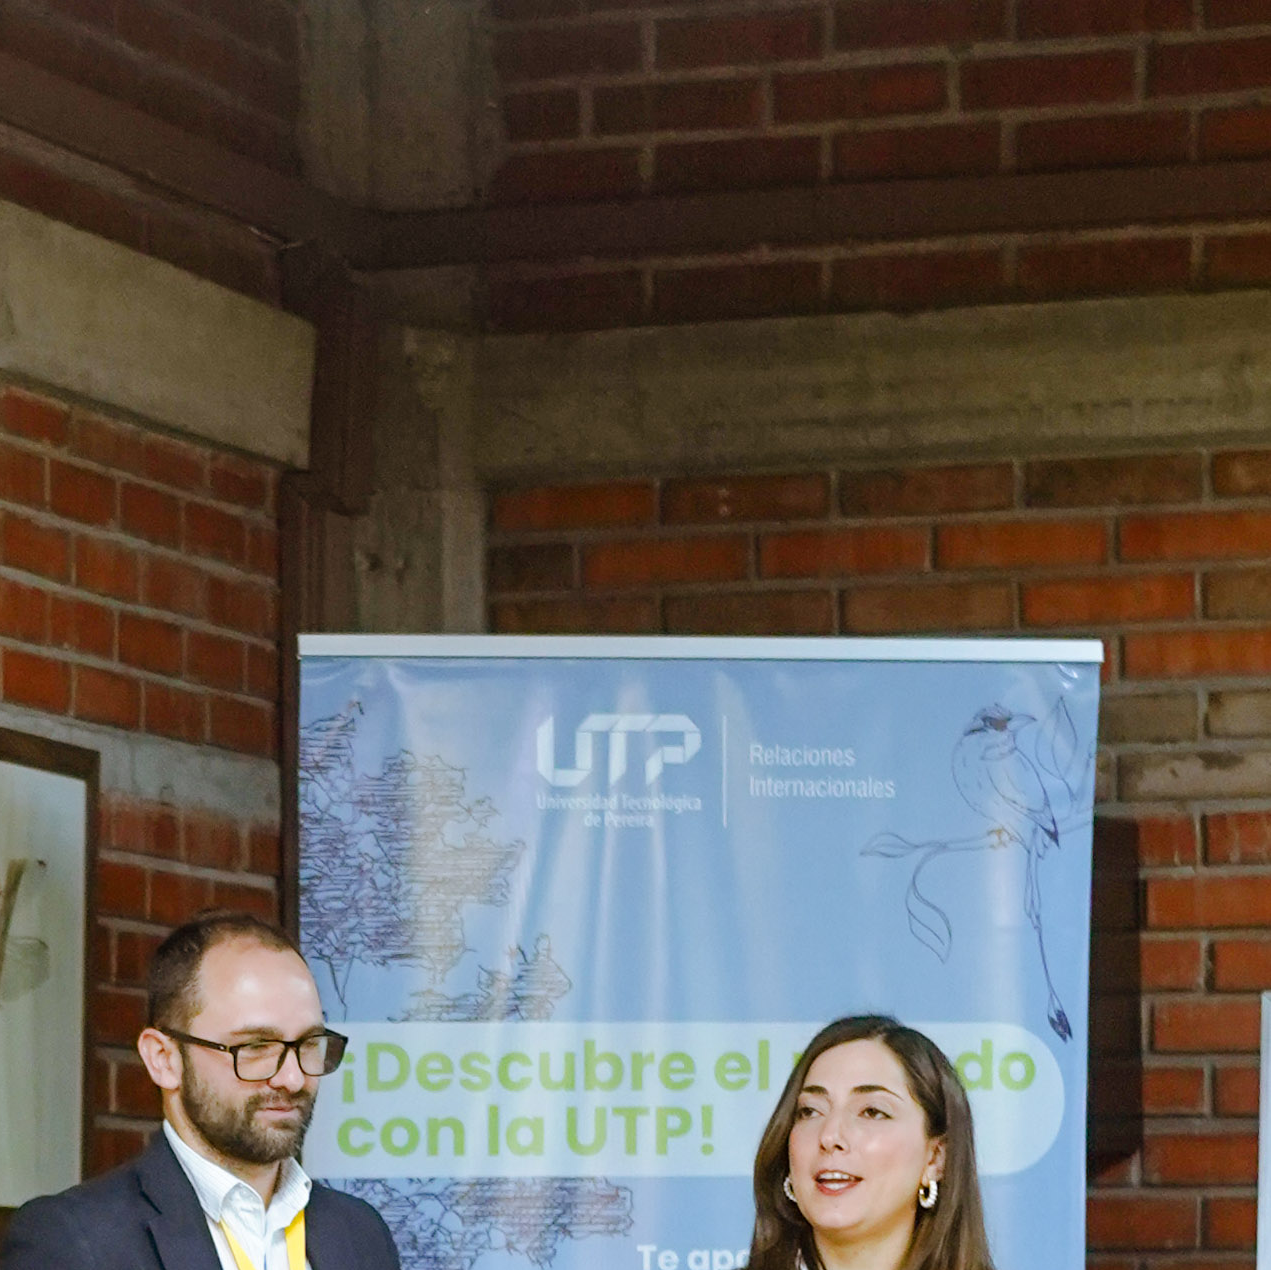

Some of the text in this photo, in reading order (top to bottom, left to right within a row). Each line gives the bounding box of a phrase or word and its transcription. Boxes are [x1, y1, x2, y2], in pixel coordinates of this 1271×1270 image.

[536, 714, 702, 787] UTP
[750, 744, 856, 767] Relaciones
[750, 776, 896, 798] Internacionales
[536, 793, 619, 810] Universidad
[584, 812, 655, 828] de Pereira
[341, 1039, 696, 1104] ¡Descubre
[713, 1039, 770, 1091] el
[336, 1104, 715, 1157] con la UTP!
